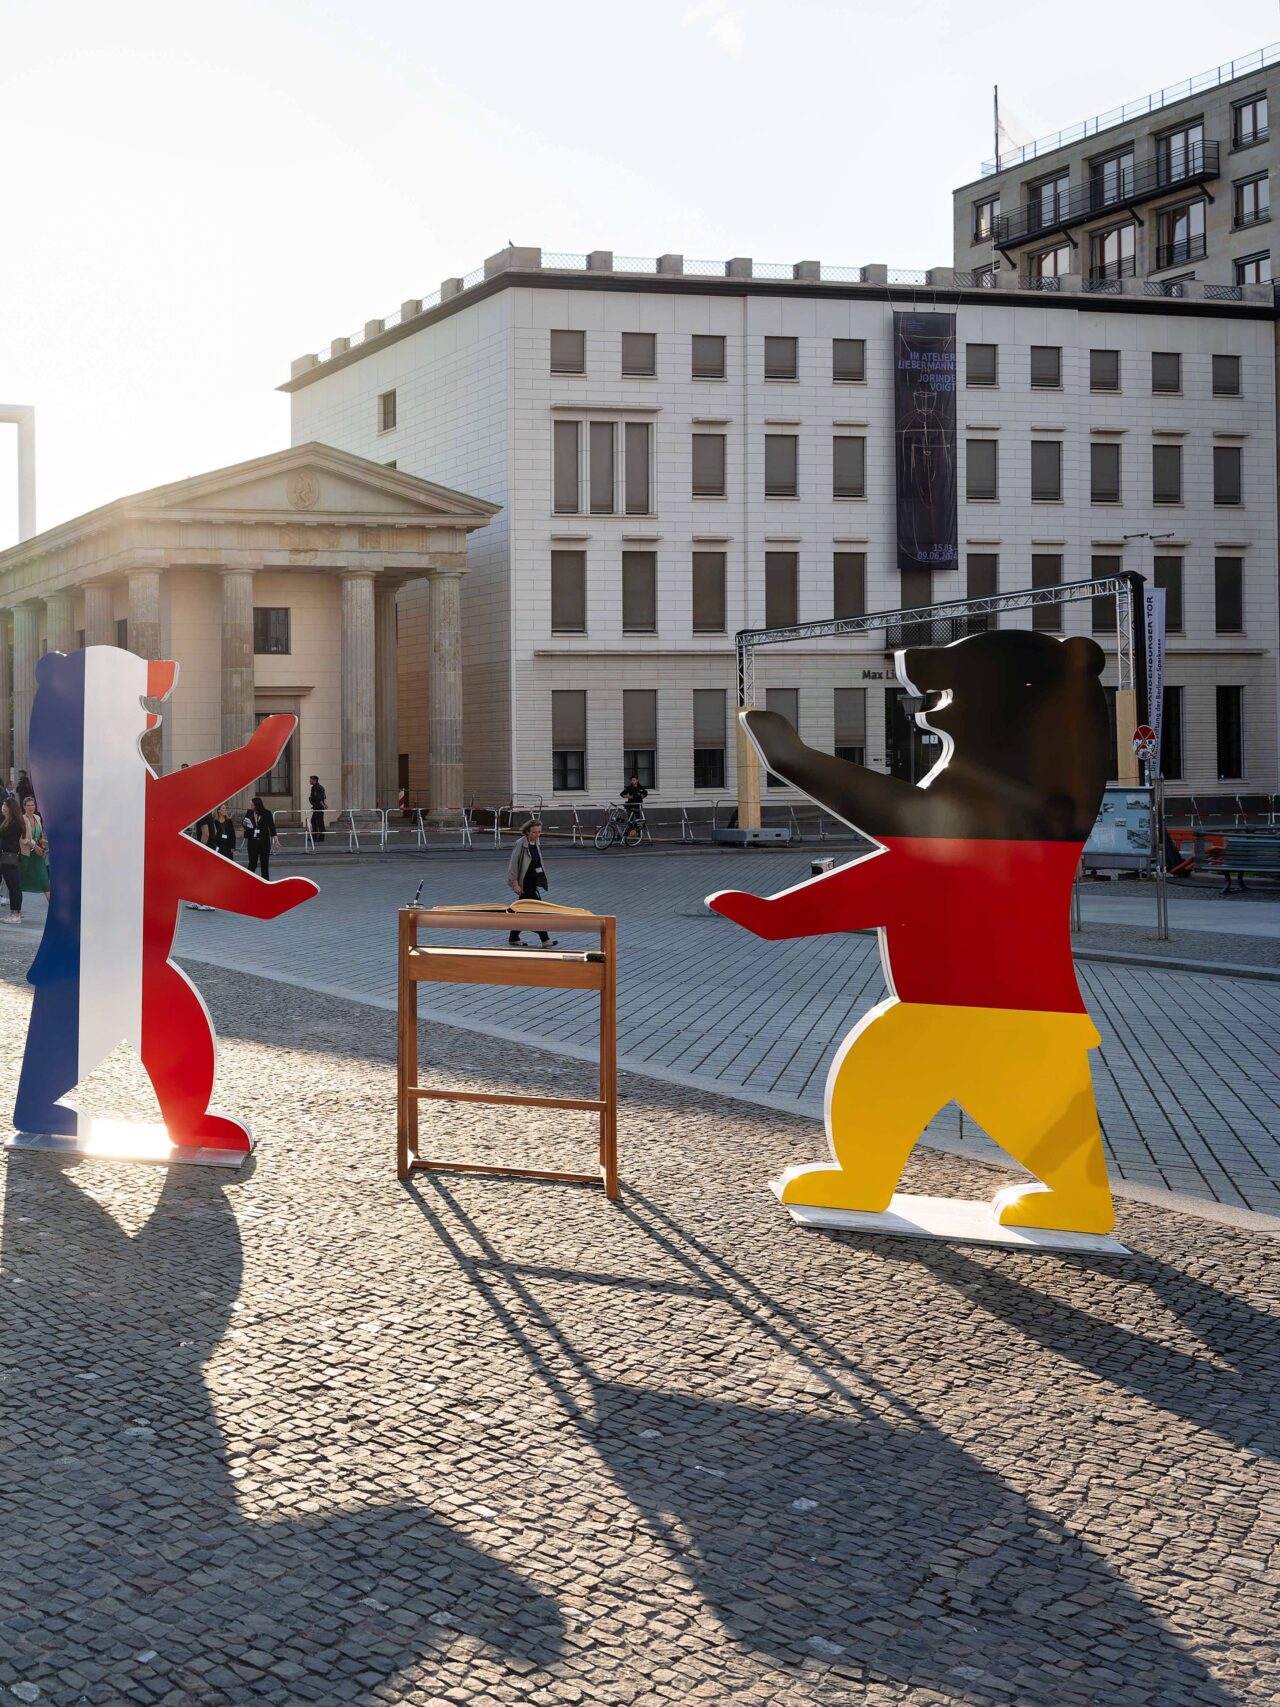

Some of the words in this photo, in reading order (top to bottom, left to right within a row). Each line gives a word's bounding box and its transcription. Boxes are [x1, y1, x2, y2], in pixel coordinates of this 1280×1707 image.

[910, 352, 920, 361] IM
[921, 352, 956, 361] ATELIER
[918, 374, 957, 383] JORINDE
[930, 383, 956, 392] VOIGT
[917, 551, 958, 561] 09.06.2024
[862, 669, 883, 680] Max
[886, 669, 896, 680] Li
